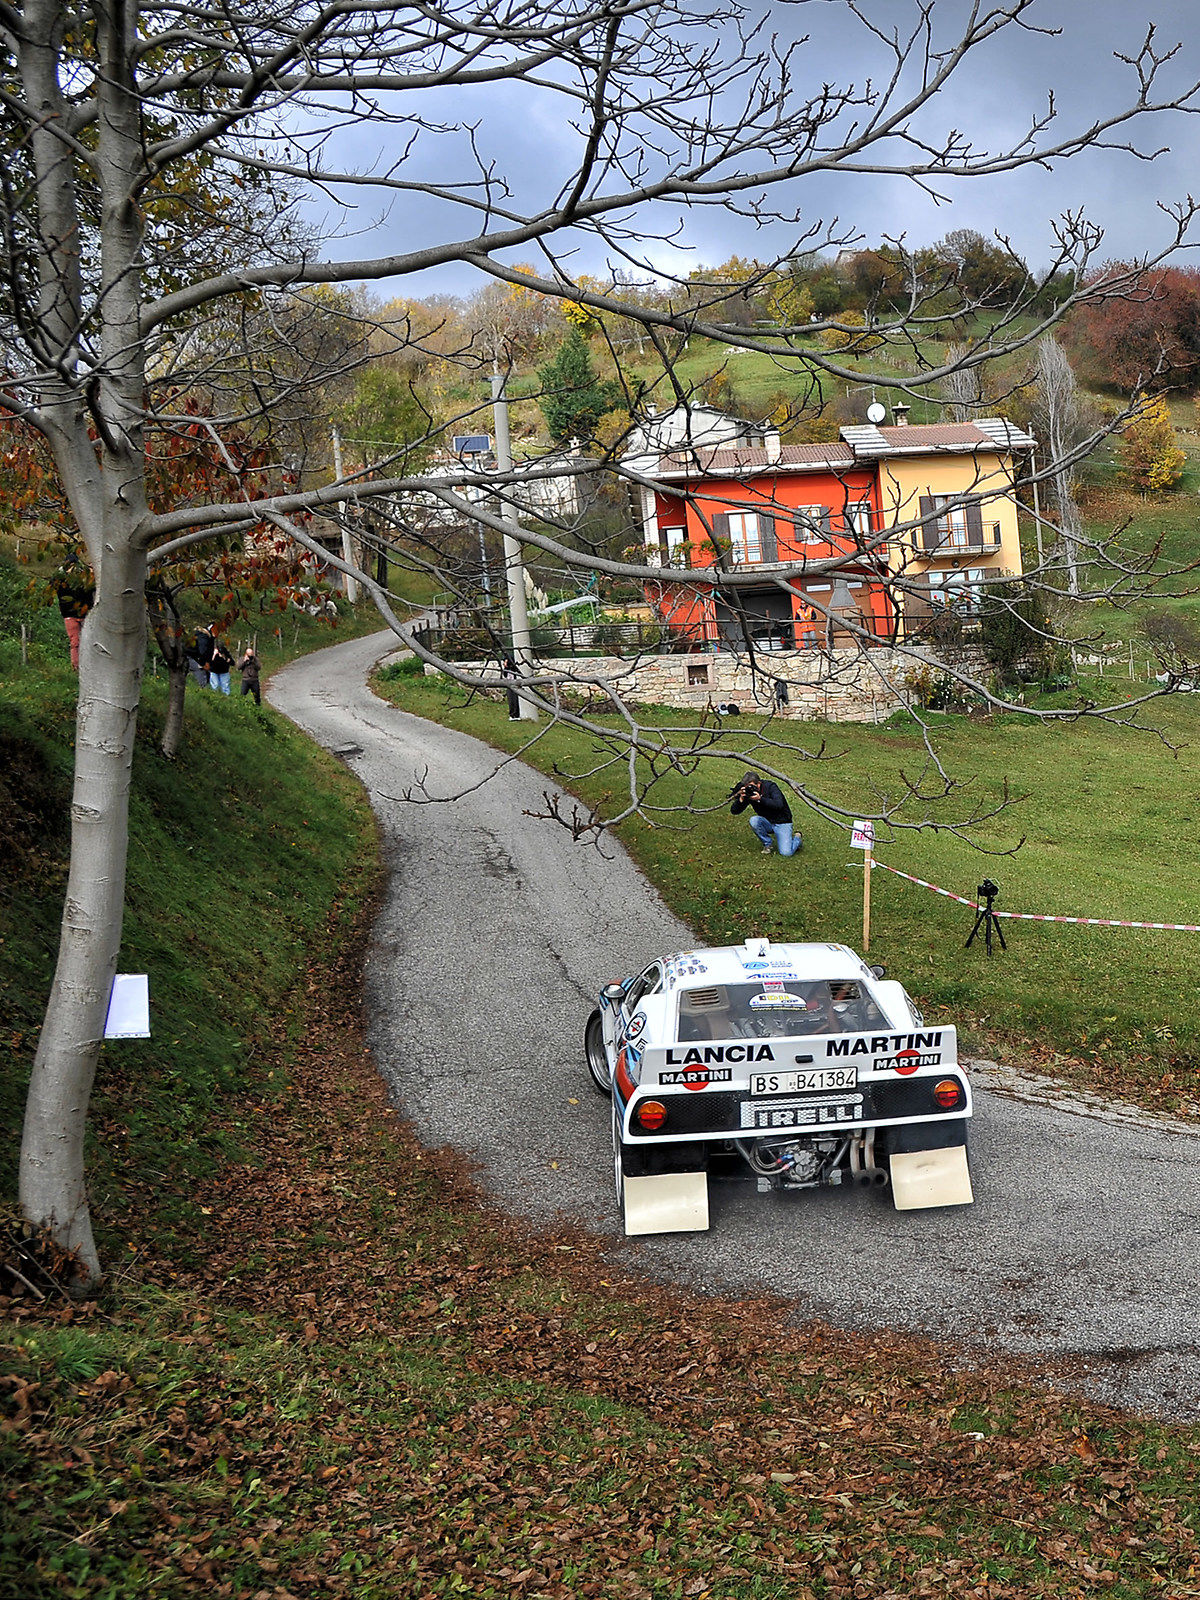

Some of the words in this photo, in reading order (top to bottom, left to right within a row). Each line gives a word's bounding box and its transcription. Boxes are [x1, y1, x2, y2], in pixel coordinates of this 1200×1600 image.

[665, 1044, 775, 1065] LANCIA
[825, 1031, 943, 1058] MARTINI
[875, 1053, 940, 1071] MARTINI
[661, 1069, 730, 1084] MARTINI
[756, 1076, 779, 1093] BS
[796, 1068, 855, 1090] B41384
[740, 1092, 864, 1129] PIRELLI
